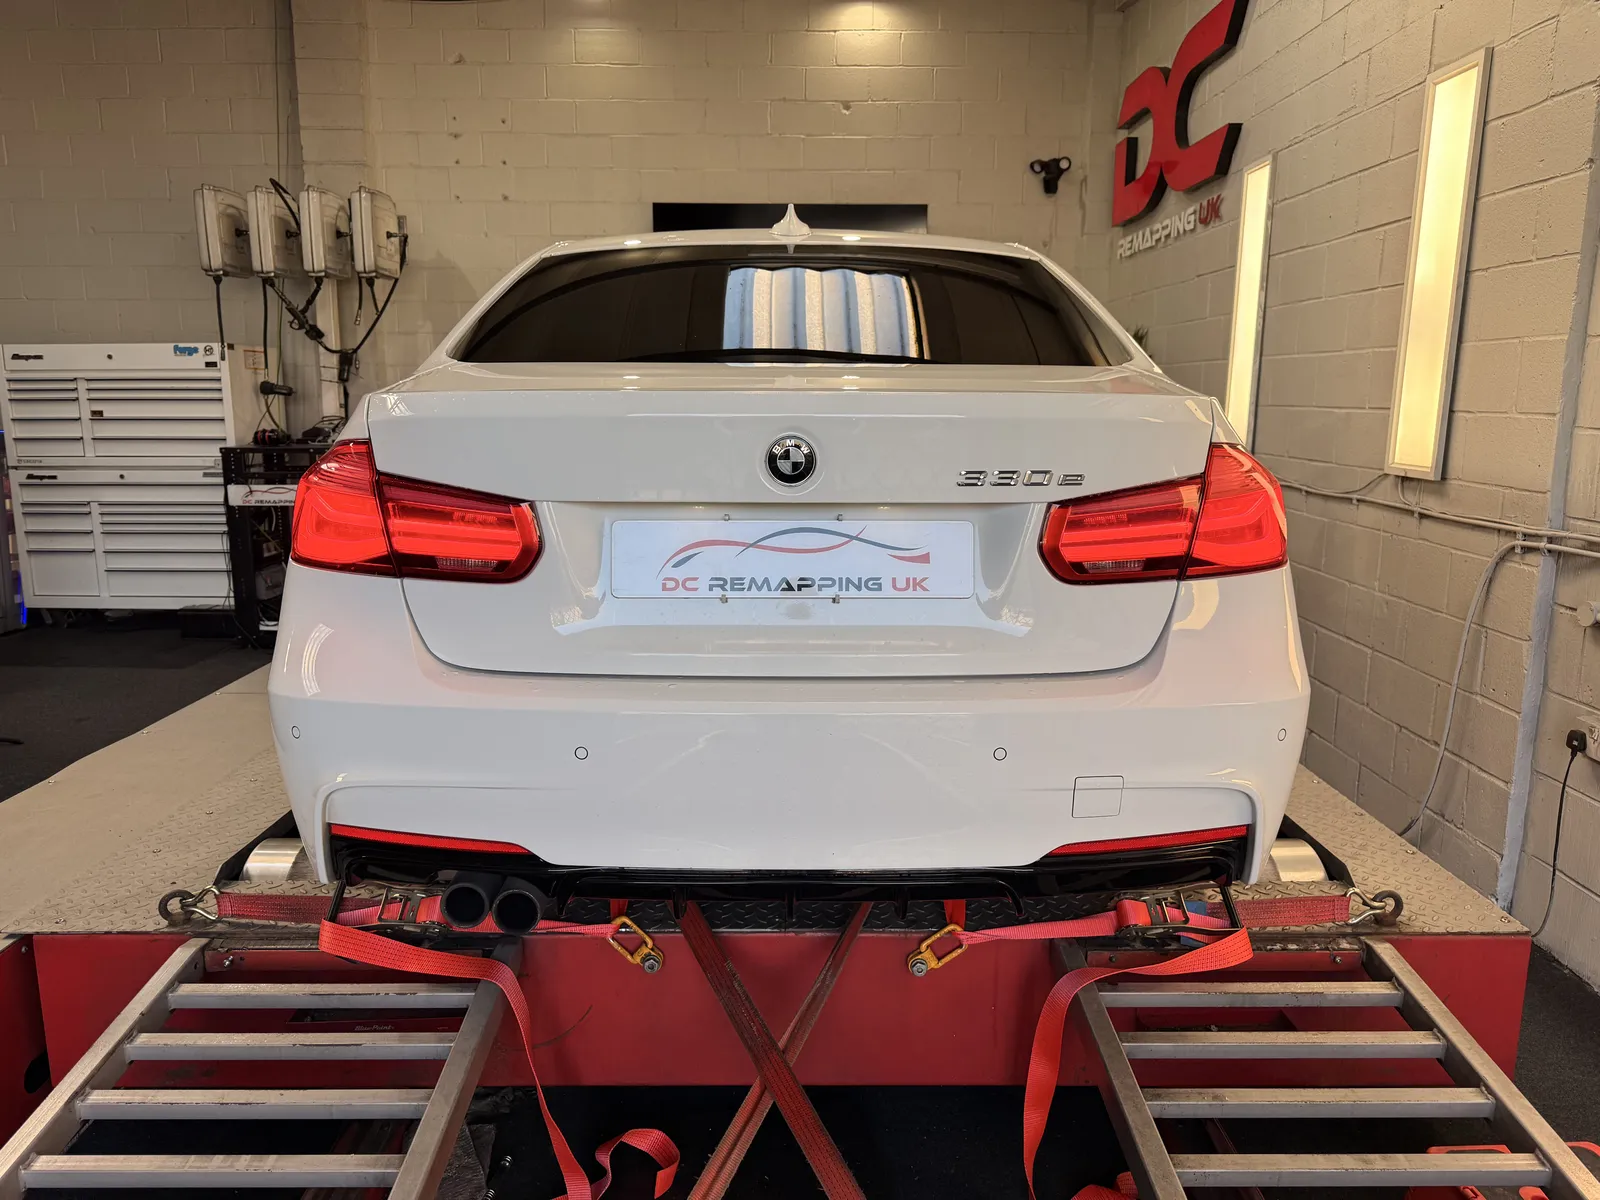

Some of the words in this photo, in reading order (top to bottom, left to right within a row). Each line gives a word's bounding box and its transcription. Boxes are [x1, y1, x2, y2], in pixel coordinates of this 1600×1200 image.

[1112, 0, 1250, 228] DC
[1117, 205, 1196, 260] REMAPPING
[1198, 193, 1222, 225] UK
[772, 439, 811, 454] BMW
[957, 469, 1085, 487] 330e
[661, 576, 700, 592] DC
[708, 576, 883, 592] REMAPPING
[891, 576, 930, 592] UK
